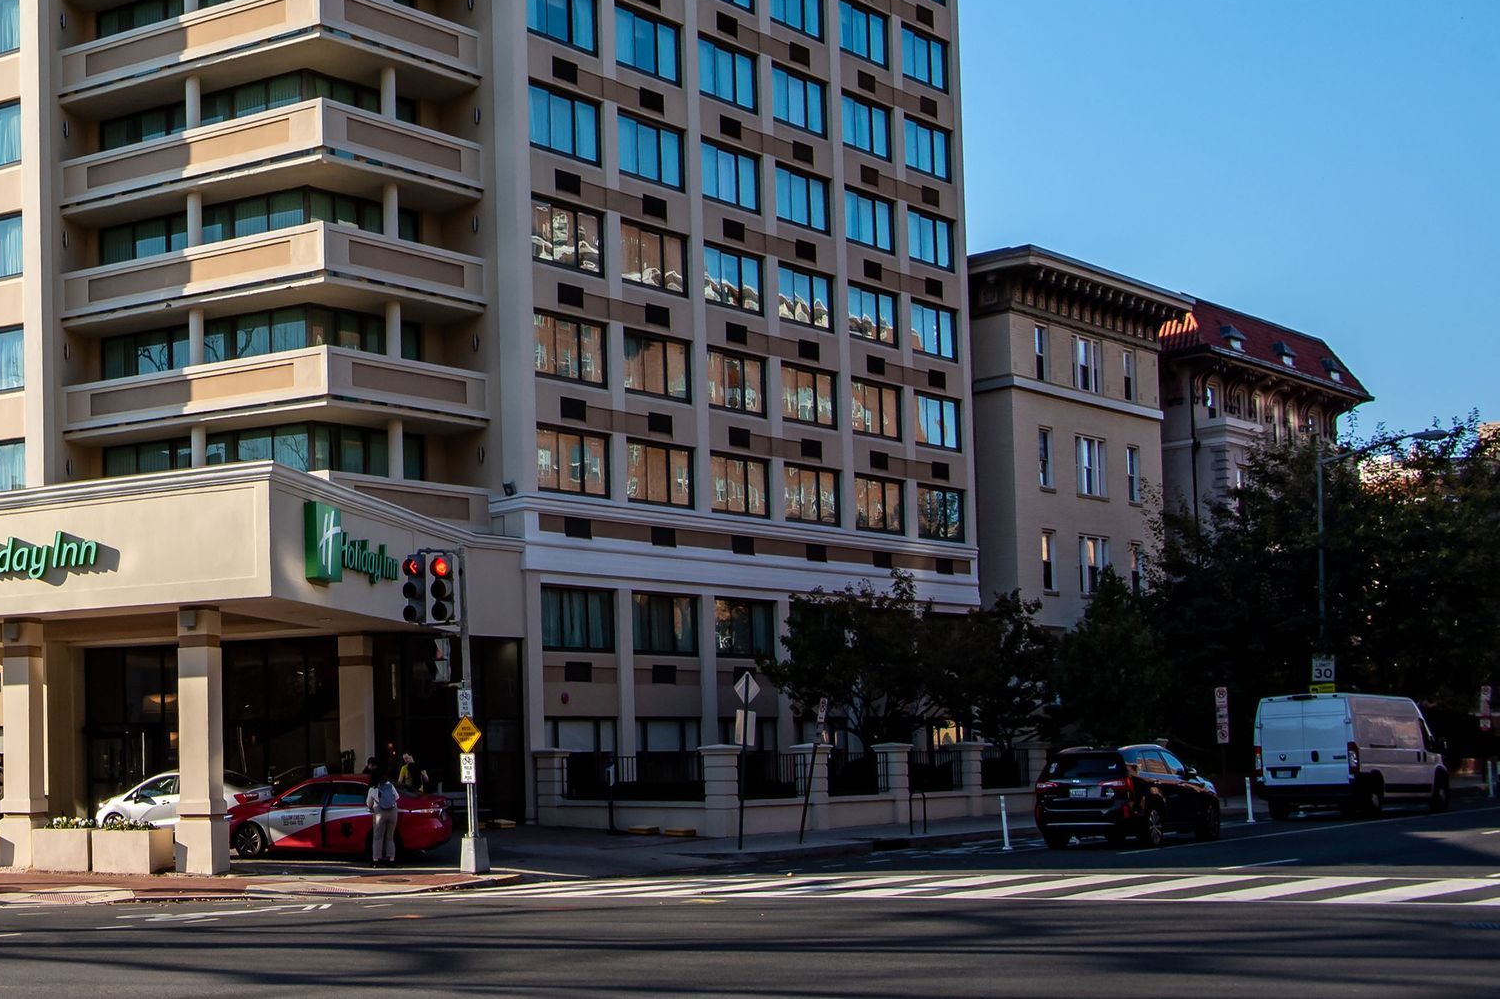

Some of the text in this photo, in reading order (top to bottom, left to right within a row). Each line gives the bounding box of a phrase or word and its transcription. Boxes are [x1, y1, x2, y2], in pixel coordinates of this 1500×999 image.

[52, 530, 98, 568] Inn
[341, 528, 399, 585] Holiday Inn
[1314, 668, 1333, 679] 30
